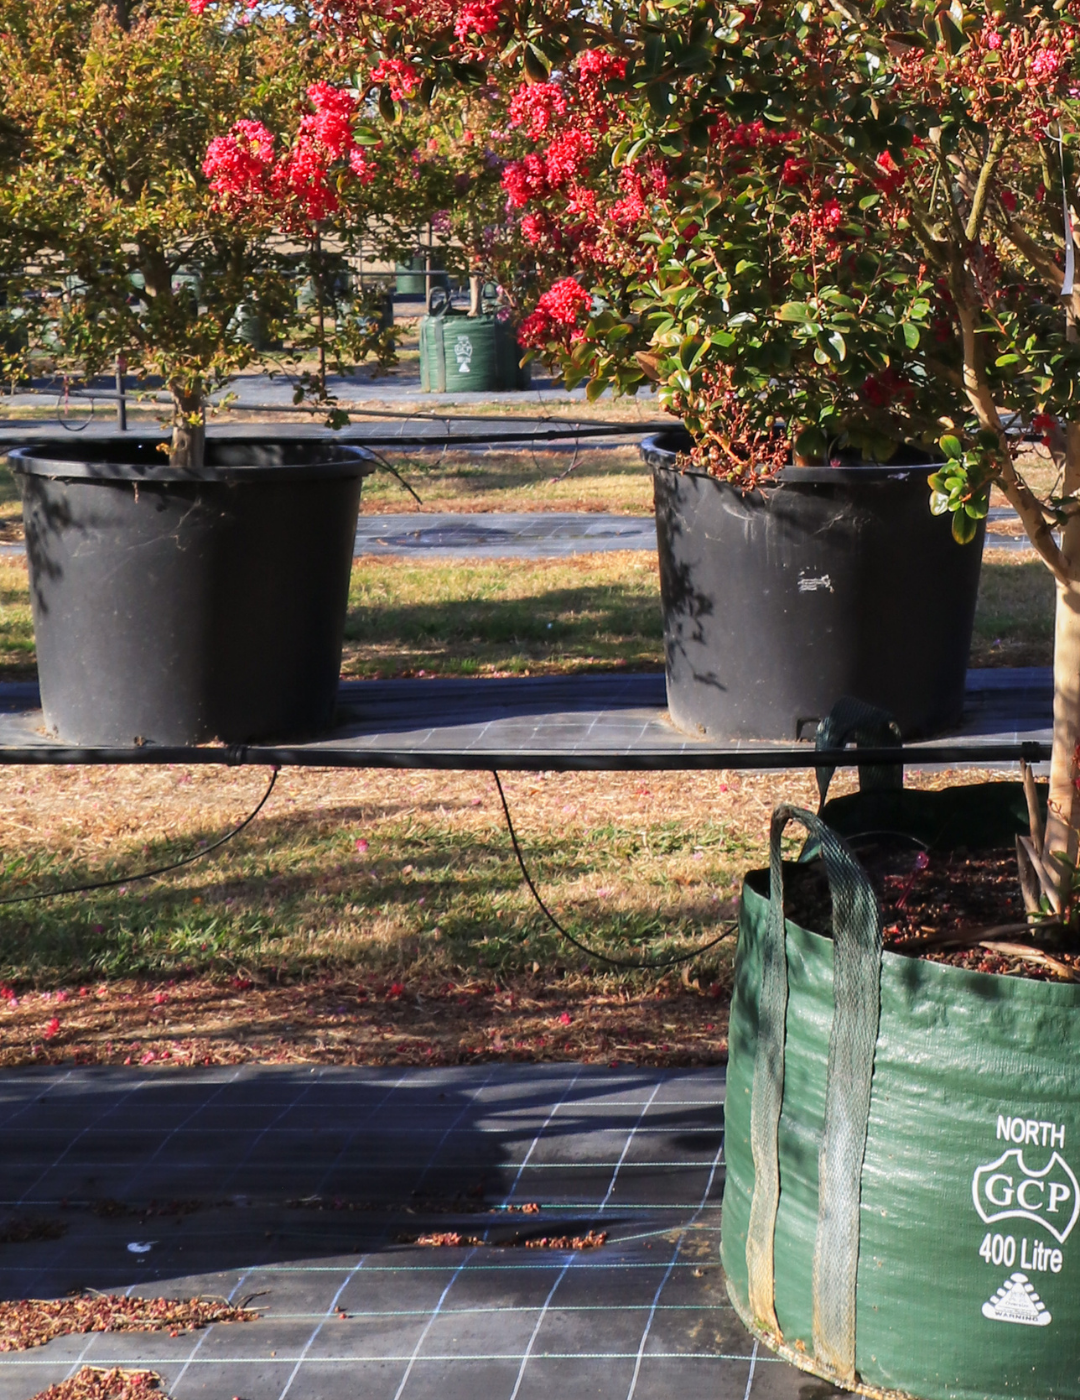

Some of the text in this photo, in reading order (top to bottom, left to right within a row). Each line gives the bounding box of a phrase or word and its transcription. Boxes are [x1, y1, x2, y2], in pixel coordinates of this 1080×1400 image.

[996, 1115, 1065, 1148] NORTH
[984, 1174, 1071, 1213] GCP
[979, 1233, 1063, 1273] 400 Litre
[995, 1311, 1039, 1322] WARNING
